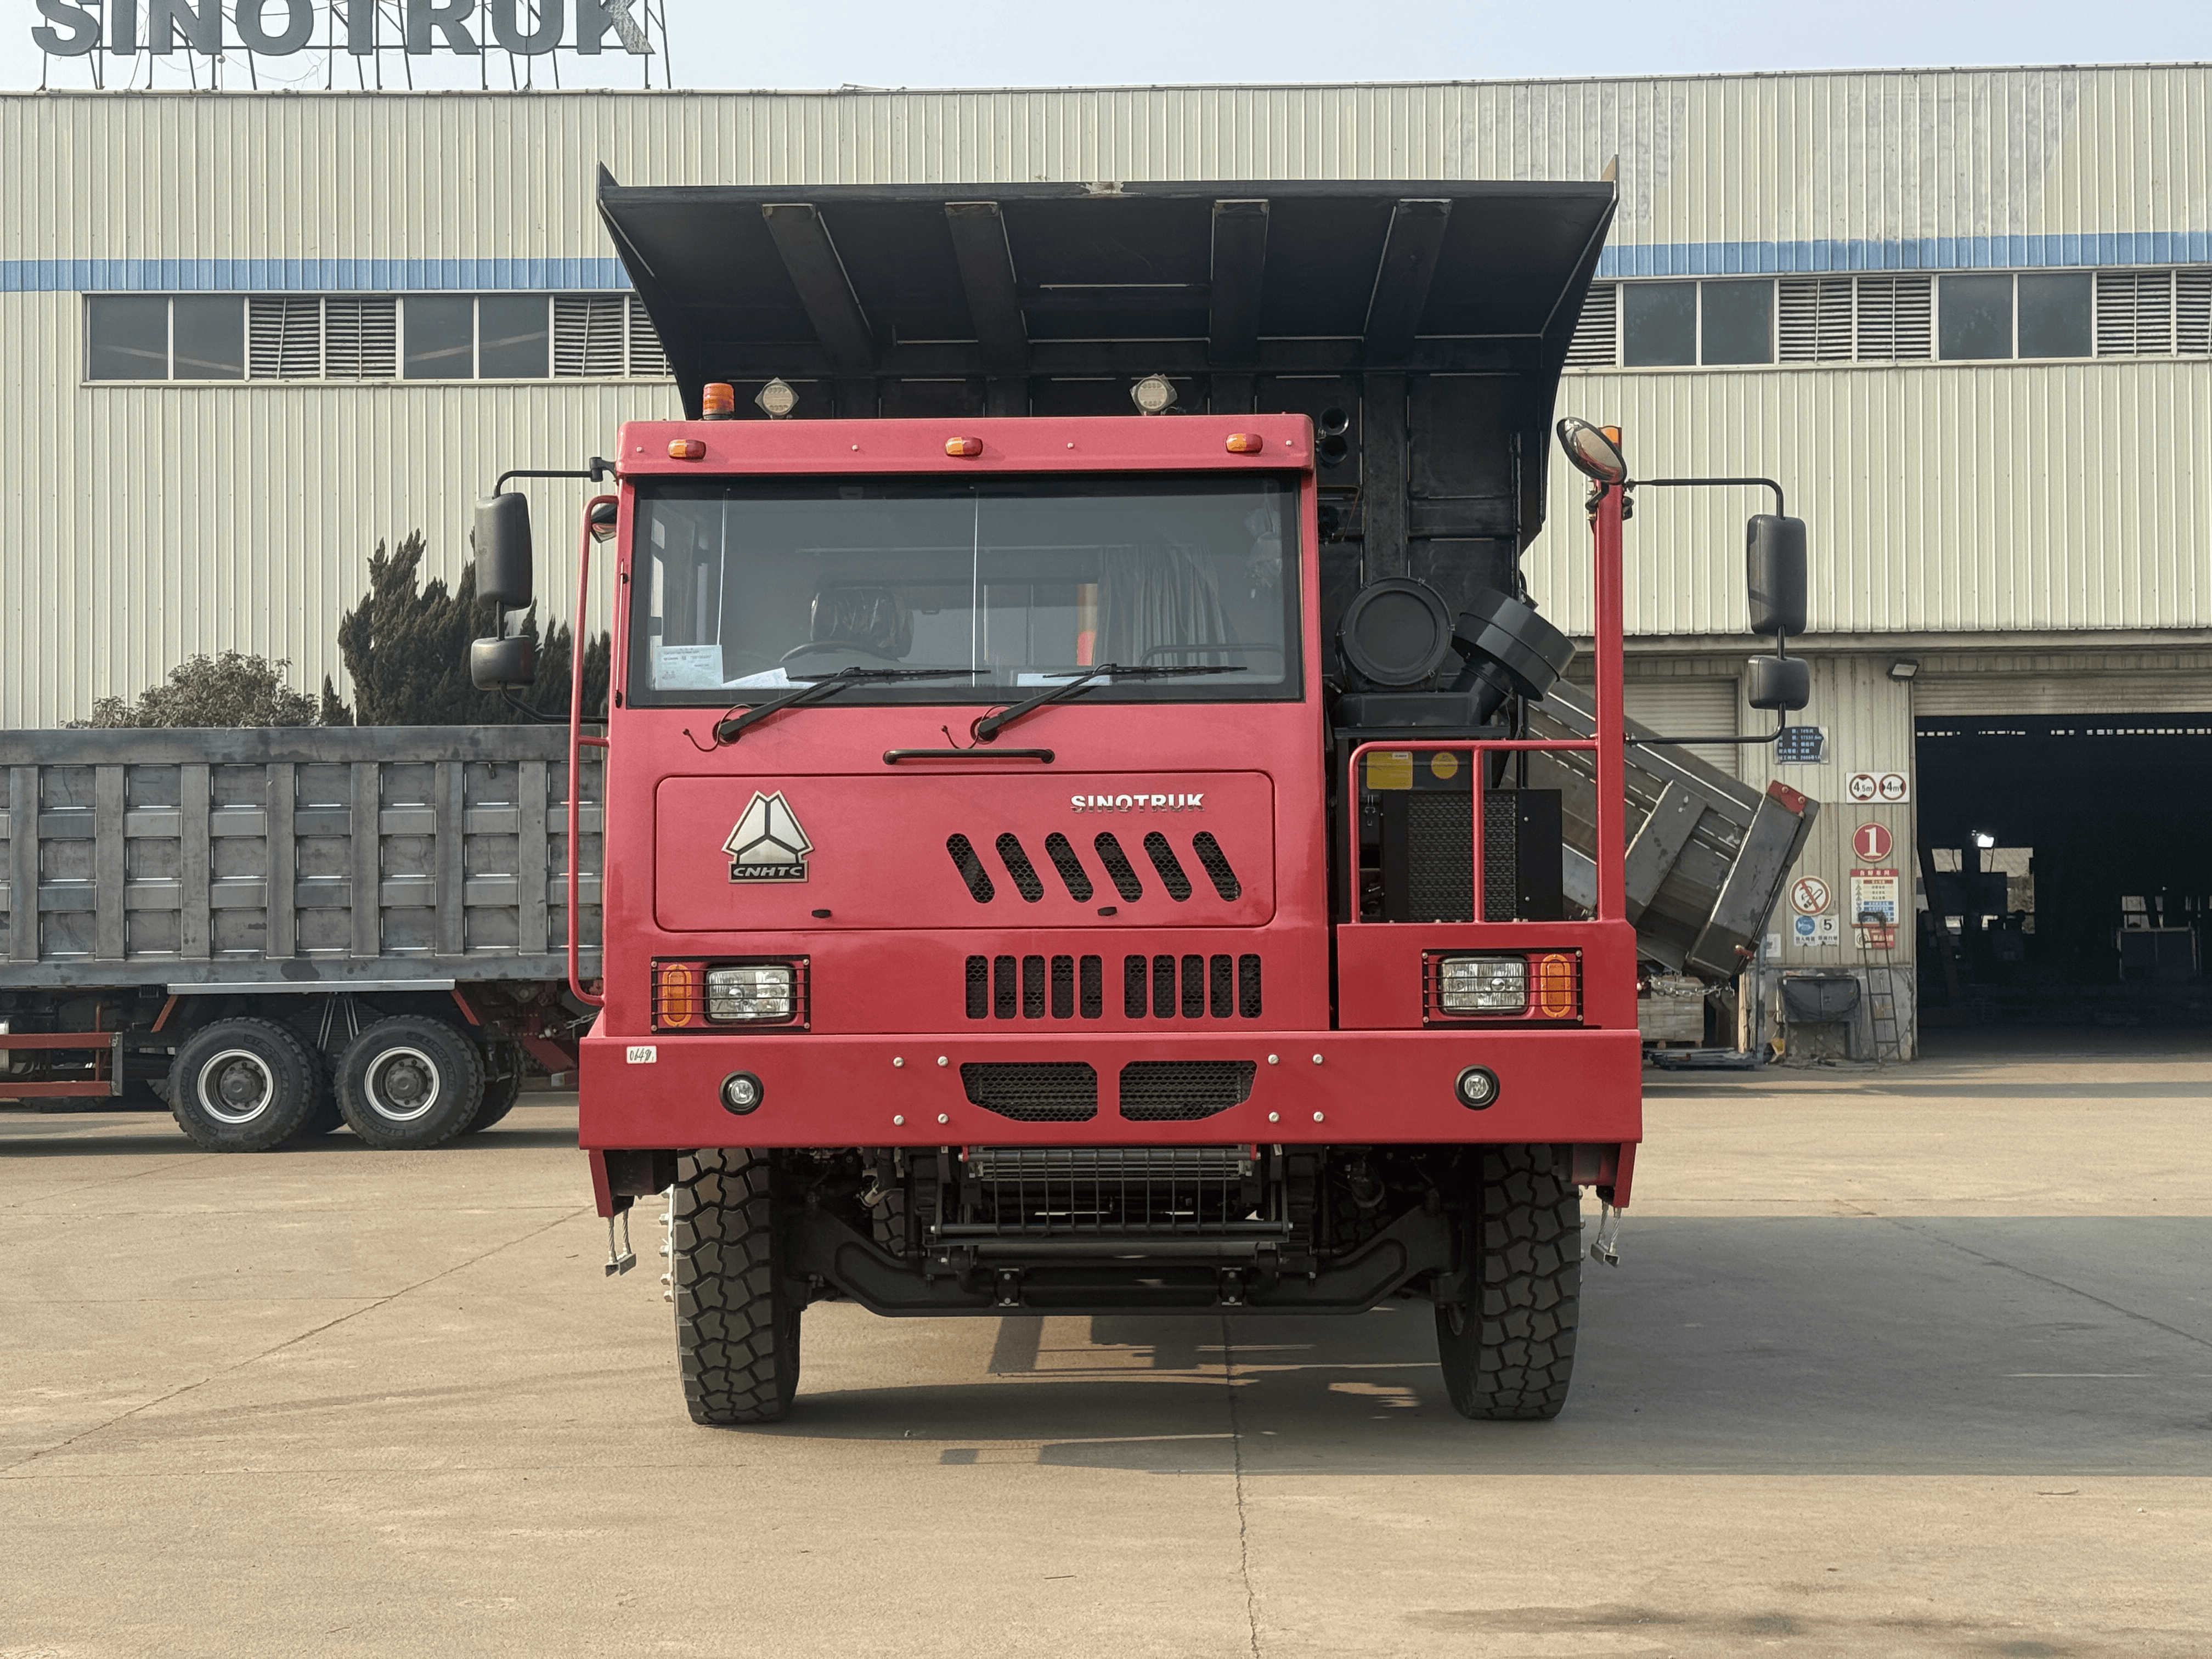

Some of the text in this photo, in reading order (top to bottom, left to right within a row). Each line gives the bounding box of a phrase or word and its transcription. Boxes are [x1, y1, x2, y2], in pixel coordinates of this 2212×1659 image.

[1886, 781, 1899, 792] 4m
[1070, 793, 1205, 813] SINOTRUK
[1864, 827, 1882, 856] 1
[733, 866, 803, 877] CNHTC
[1824, 918, 1832, 931] 5
